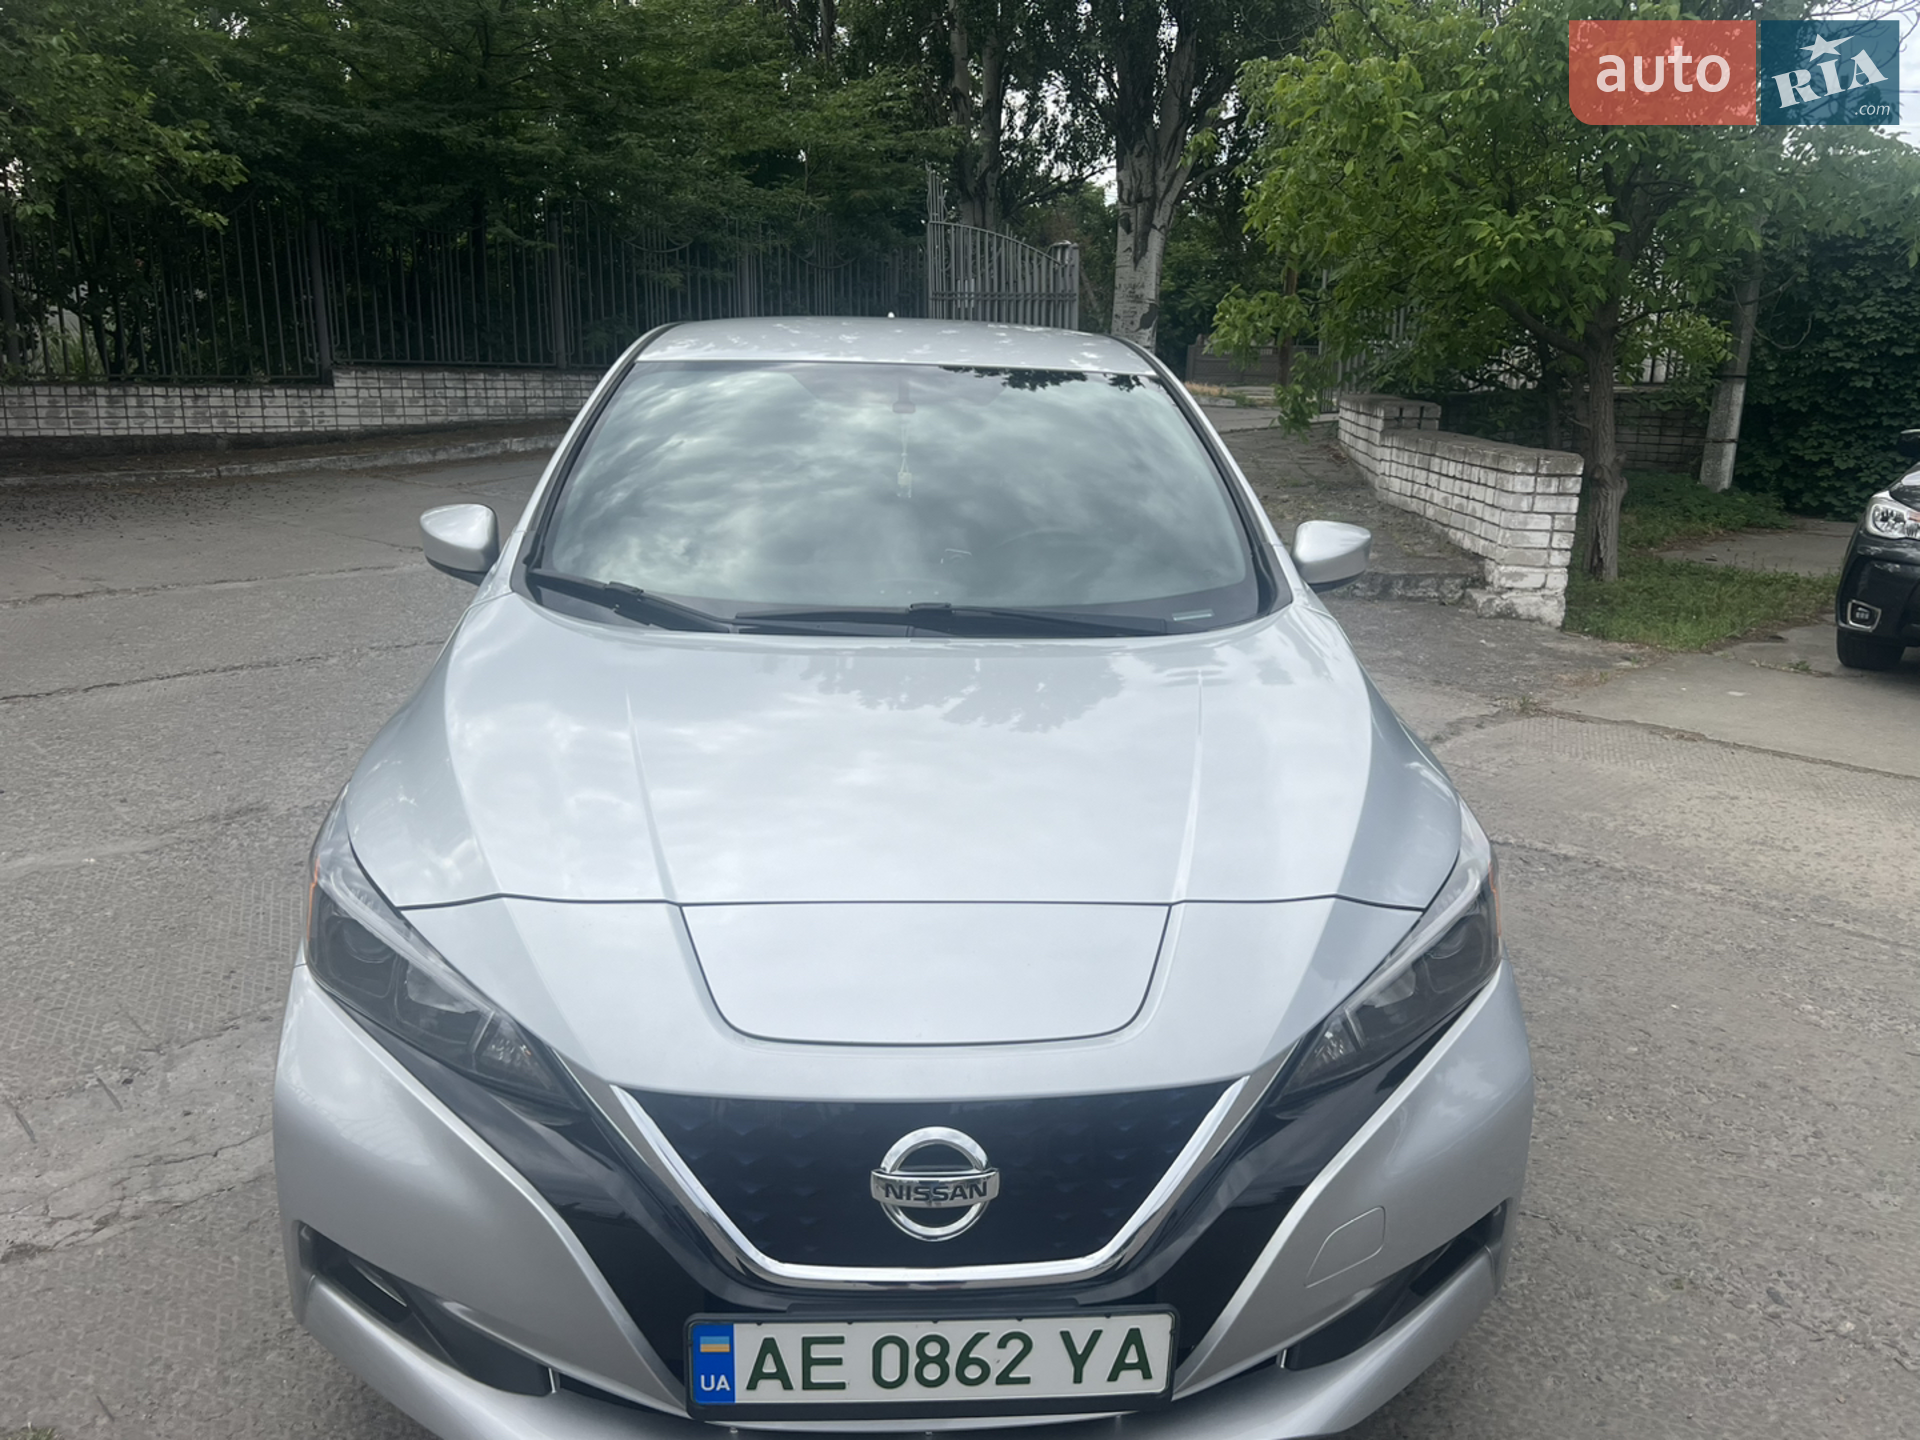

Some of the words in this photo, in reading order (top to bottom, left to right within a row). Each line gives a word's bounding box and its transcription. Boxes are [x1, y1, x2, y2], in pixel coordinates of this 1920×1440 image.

[884, 1181, 988, 1202] NISSAN
[746, 1335, 847, 1391] AE
[871, 1331, 1034, 1389] 0862
[1059, 1327, 1154, 1384] YA
[700, 1374, 731, 1392] UA
